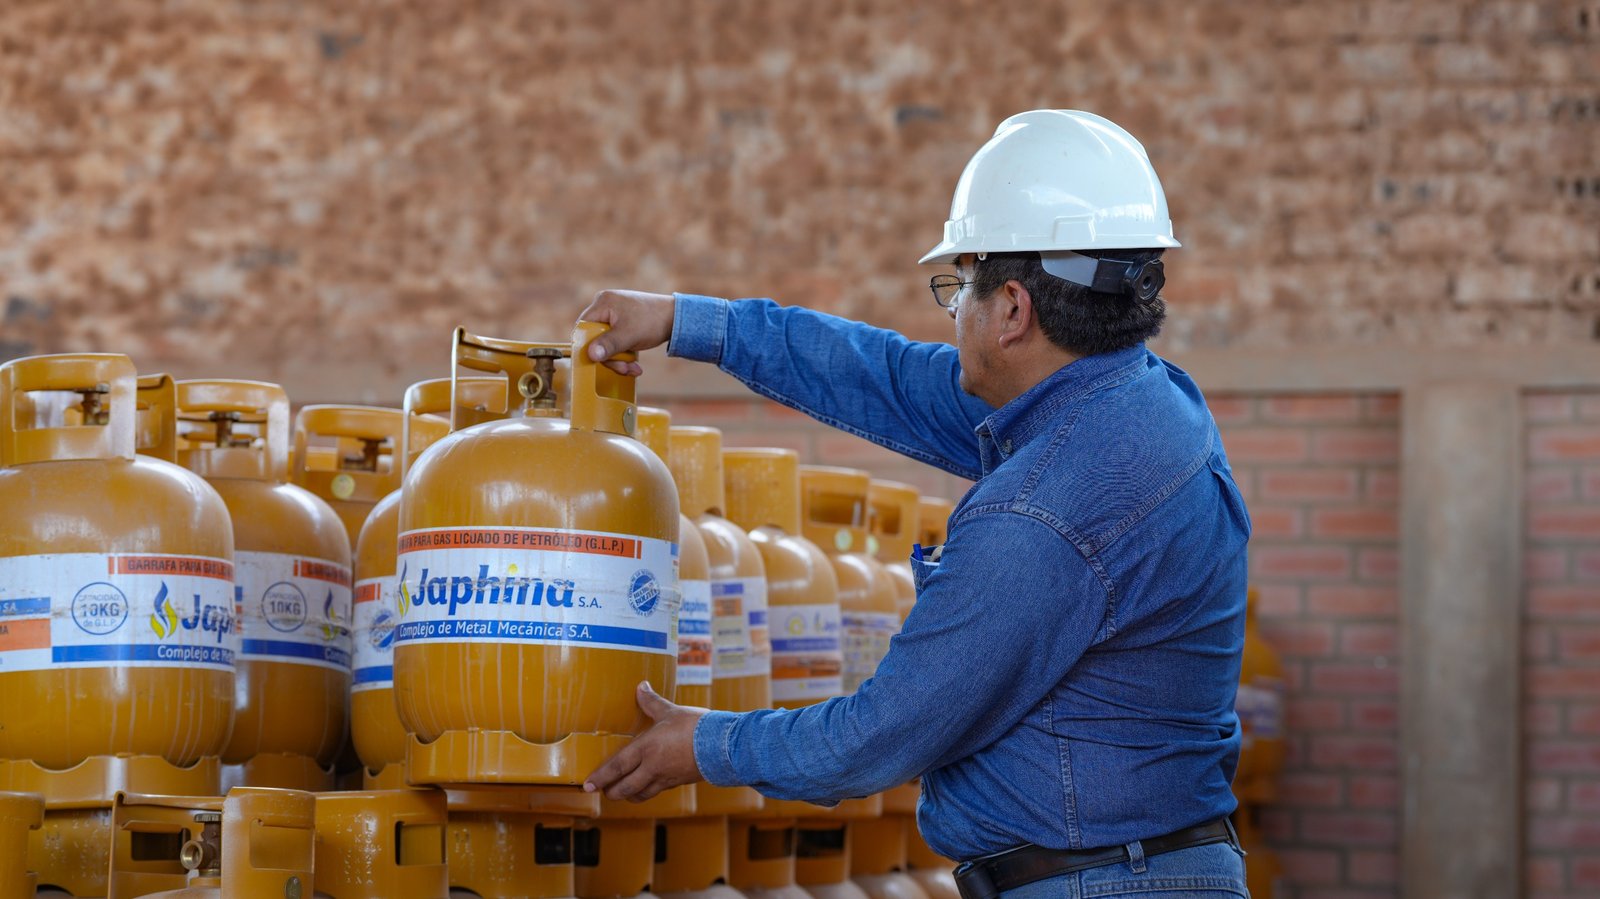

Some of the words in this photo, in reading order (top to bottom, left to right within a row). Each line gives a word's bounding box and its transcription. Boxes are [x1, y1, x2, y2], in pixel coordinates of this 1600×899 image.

[414, 535, 432, 547] PARA
[433, 533, 451, 545] GAS
[453, 532, 500, 545] LICUADO
[503, 533, 519, 545] DE
[522, 532, 582, 548] PETRÓLEO
[585, 537, 625, 554] (G.L.P.)
[128, 559, 177, 571] GARRAFA
[180, 560, 201, 573] PARA
[411, 565, 575, 616] Japhina
[578, 596, 602, 609] S.A.
[81, 603, 120, 617] 10KG
[270, 600, 302, 616] 10KG
[399, 622, 435, 638] Complejo
[438, 621, 451, 634] de
[455, 621, 493, 635] Metal
[498, 621, 563, 637] Mecánica
[567, 624, 592, 639] S.A.
[157, 645, 209, 661] Complejo
